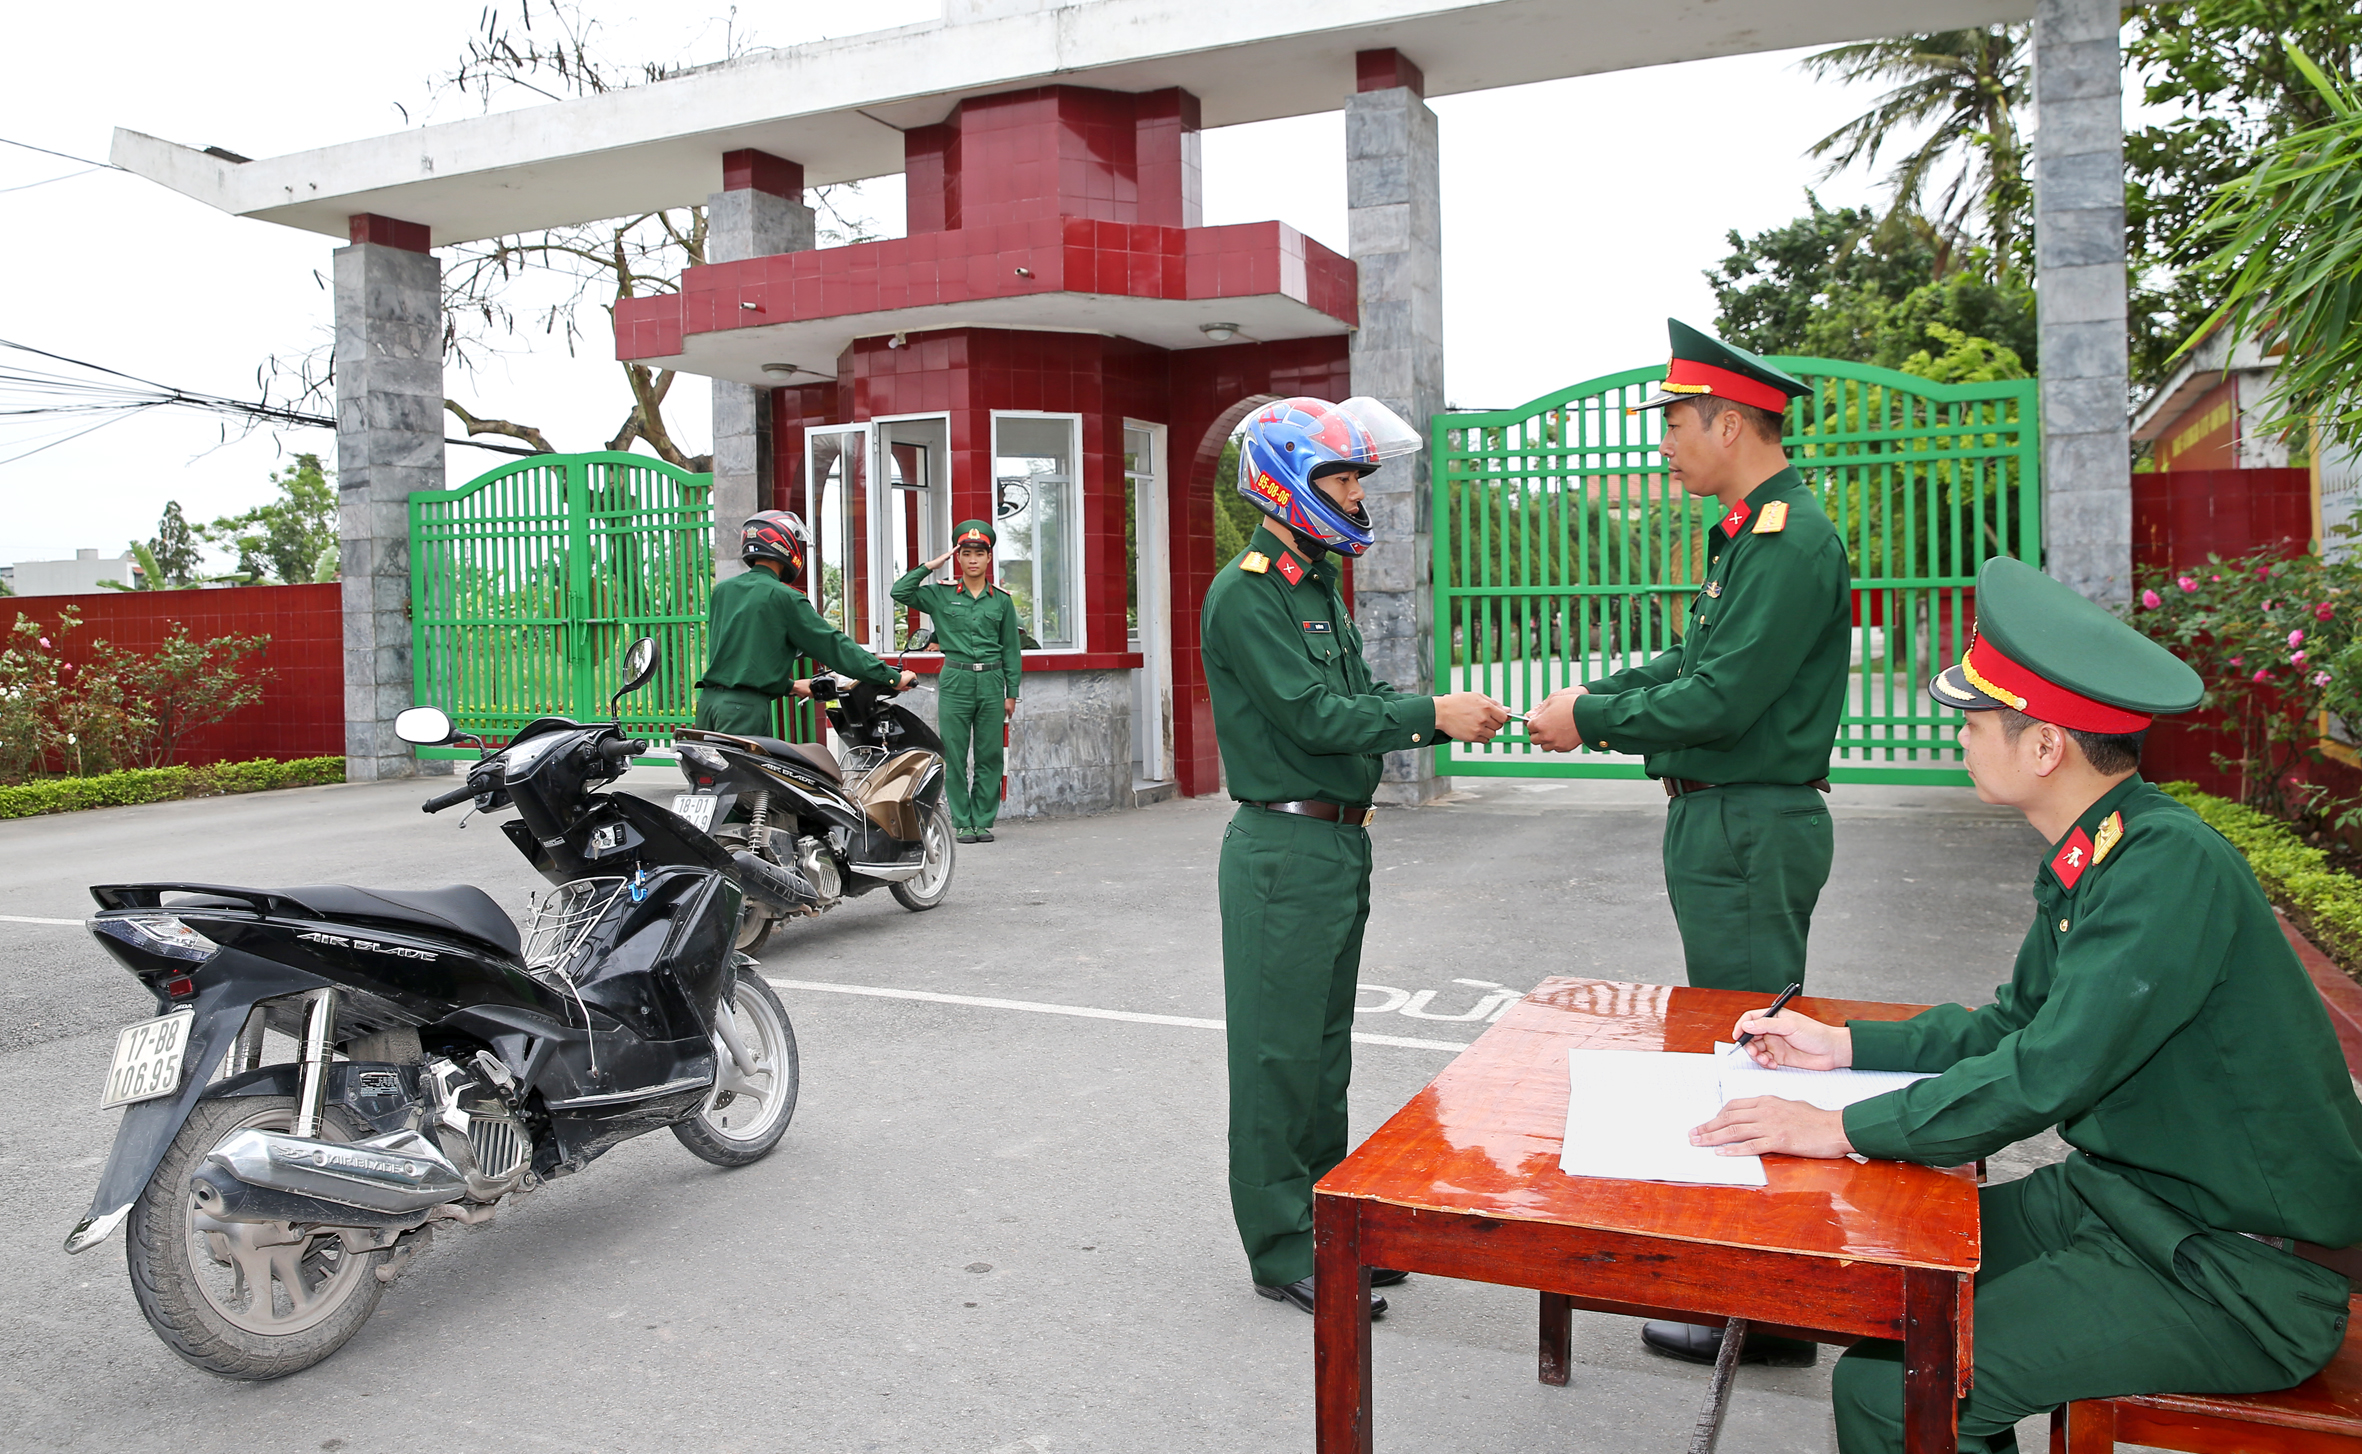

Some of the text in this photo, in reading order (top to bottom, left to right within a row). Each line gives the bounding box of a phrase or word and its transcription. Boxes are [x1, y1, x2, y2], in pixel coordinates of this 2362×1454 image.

[1257, 474, 1290, 505] 95-08-06
[761, 763, 816, 786] AIR BLADE
[679, 798, 709, 813] 18-D1
[297, 932, 438, 961] AIR BLADE
[127, 1019, 180, 1062] 17-B8
[111, 1054, 179, 1101] 106.95
